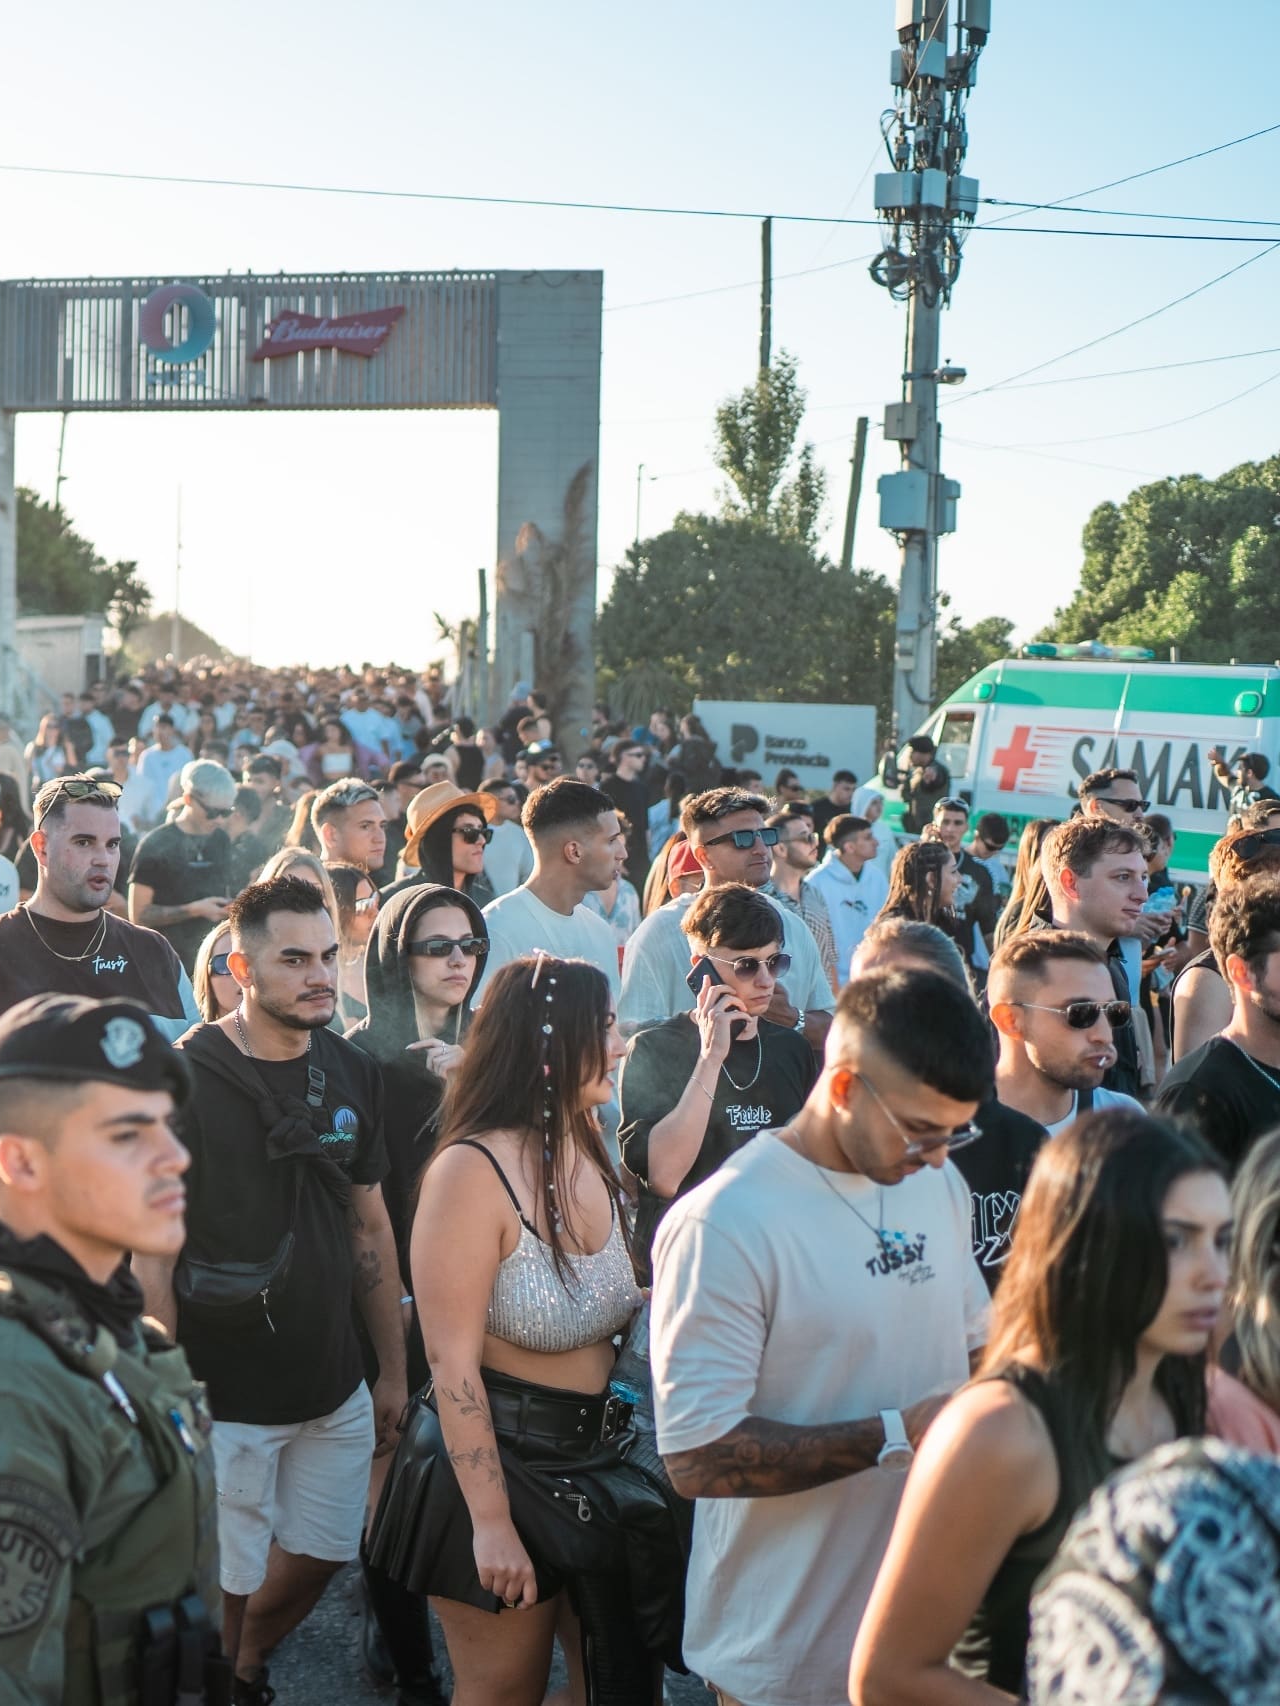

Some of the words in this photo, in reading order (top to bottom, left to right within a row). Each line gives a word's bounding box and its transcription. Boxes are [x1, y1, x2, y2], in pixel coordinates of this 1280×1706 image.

[271, 318, 388, 343] Budweiser
[764, 734, 807, 750] Banco
[764, 750, 831, 768] Provincia
